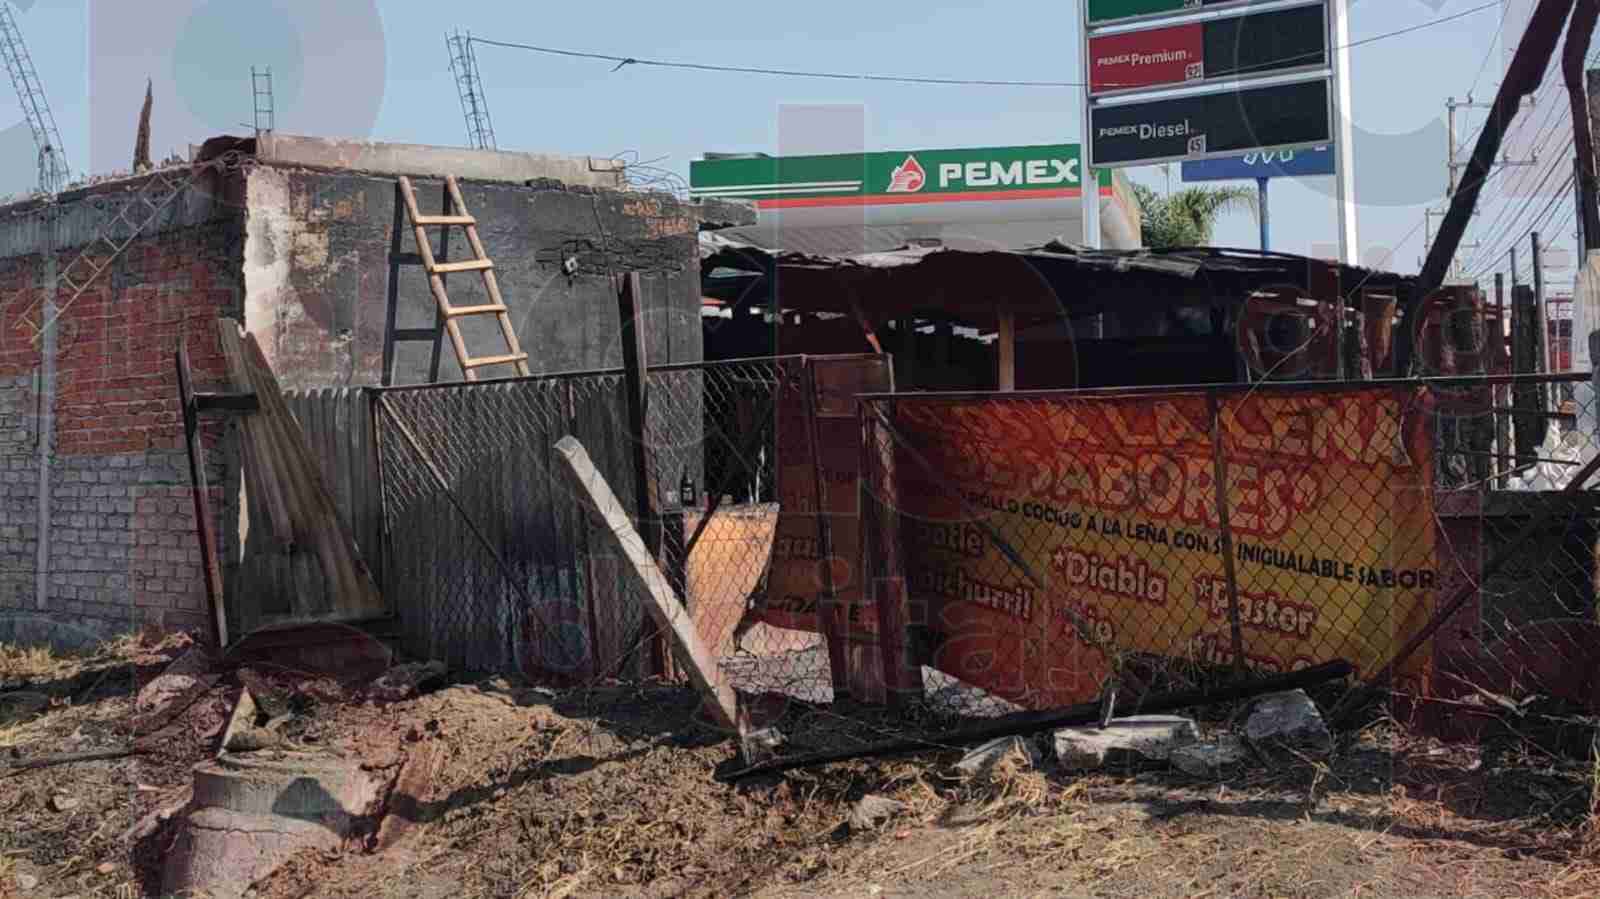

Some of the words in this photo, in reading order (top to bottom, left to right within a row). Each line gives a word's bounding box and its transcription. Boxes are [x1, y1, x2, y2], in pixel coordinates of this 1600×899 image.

[1131, 49, 1187, 66] Premium
[1140, 119, 1190, 139] Diesel
[938, 158, 1080, 188] PEMEX
[1085, 514, 1099, 533] A
[1102, 518, 1122, 537] LA
[1126, 521, 1170, 547] LEÑA
[1174, 530, 1210, 554] CON
[1237, 543, 1355, 583] INIGUALABLE
[1358, 565, 1437, 590] SABOR
